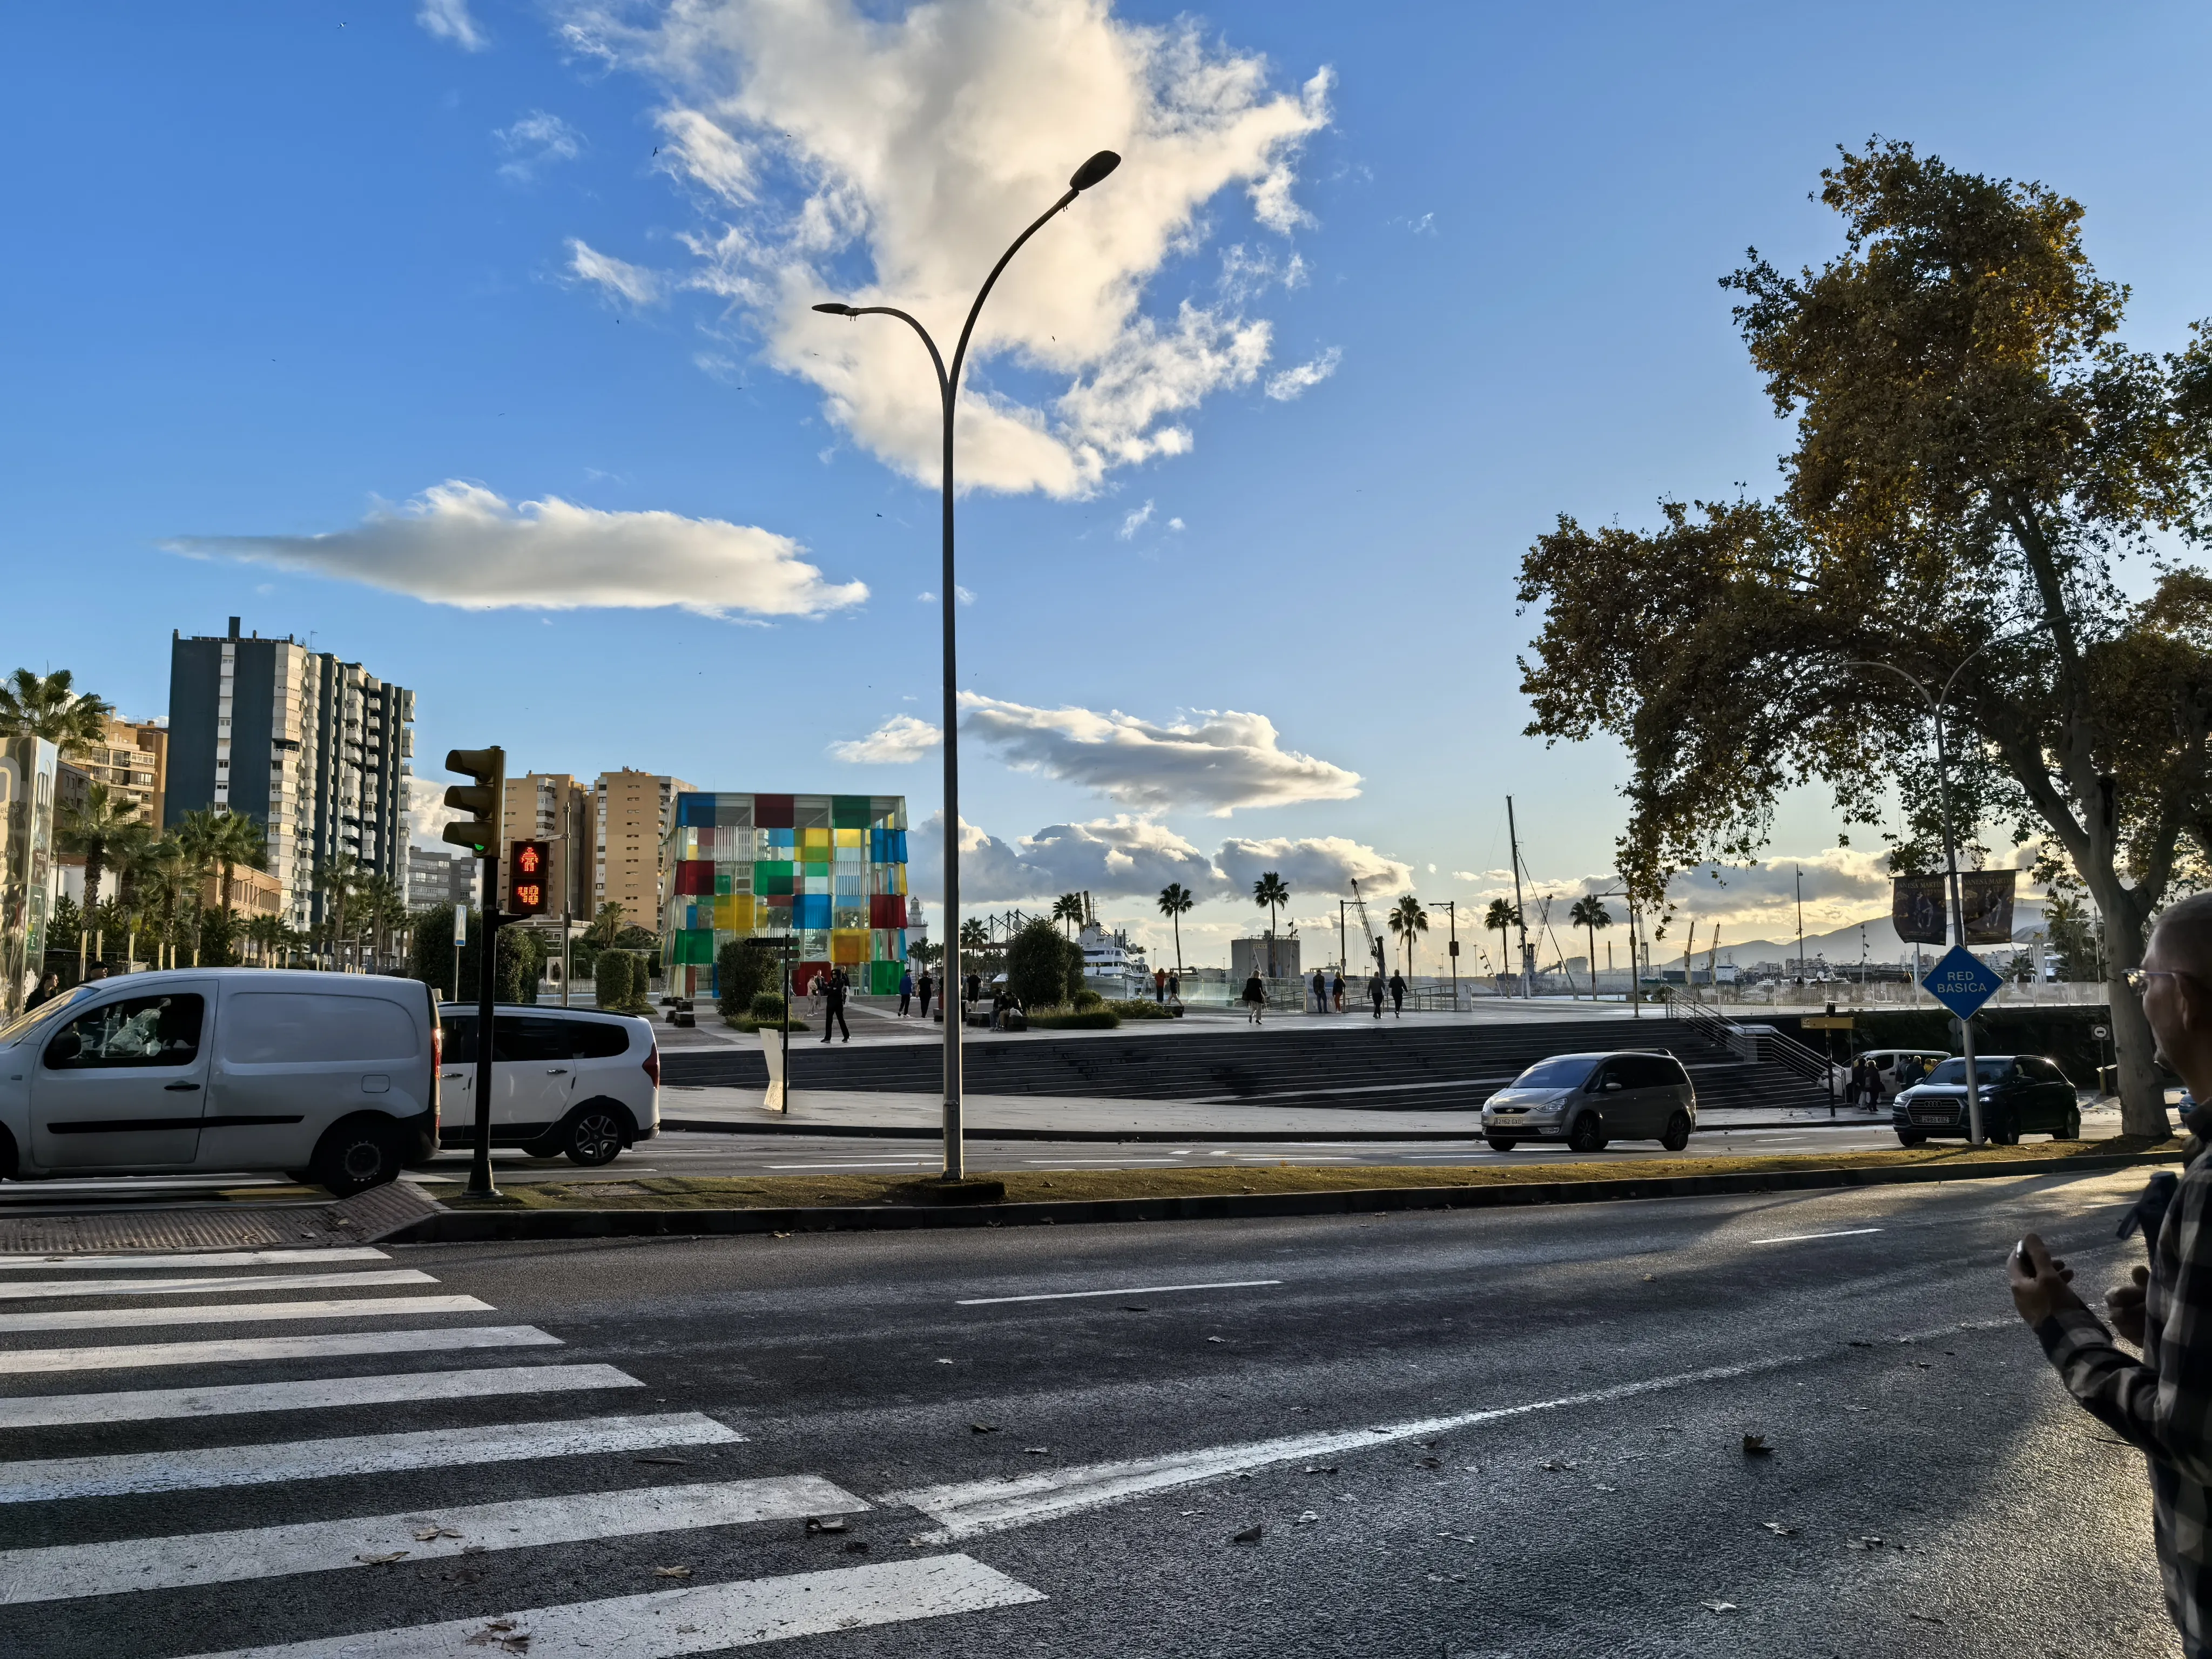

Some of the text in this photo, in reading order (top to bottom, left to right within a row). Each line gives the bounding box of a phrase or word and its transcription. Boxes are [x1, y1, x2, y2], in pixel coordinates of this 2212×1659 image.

[518, 885, 539, 905] 48
[1947, 972, 1974, 981] RED
[1937, 983, 1987, 993] BASICA
